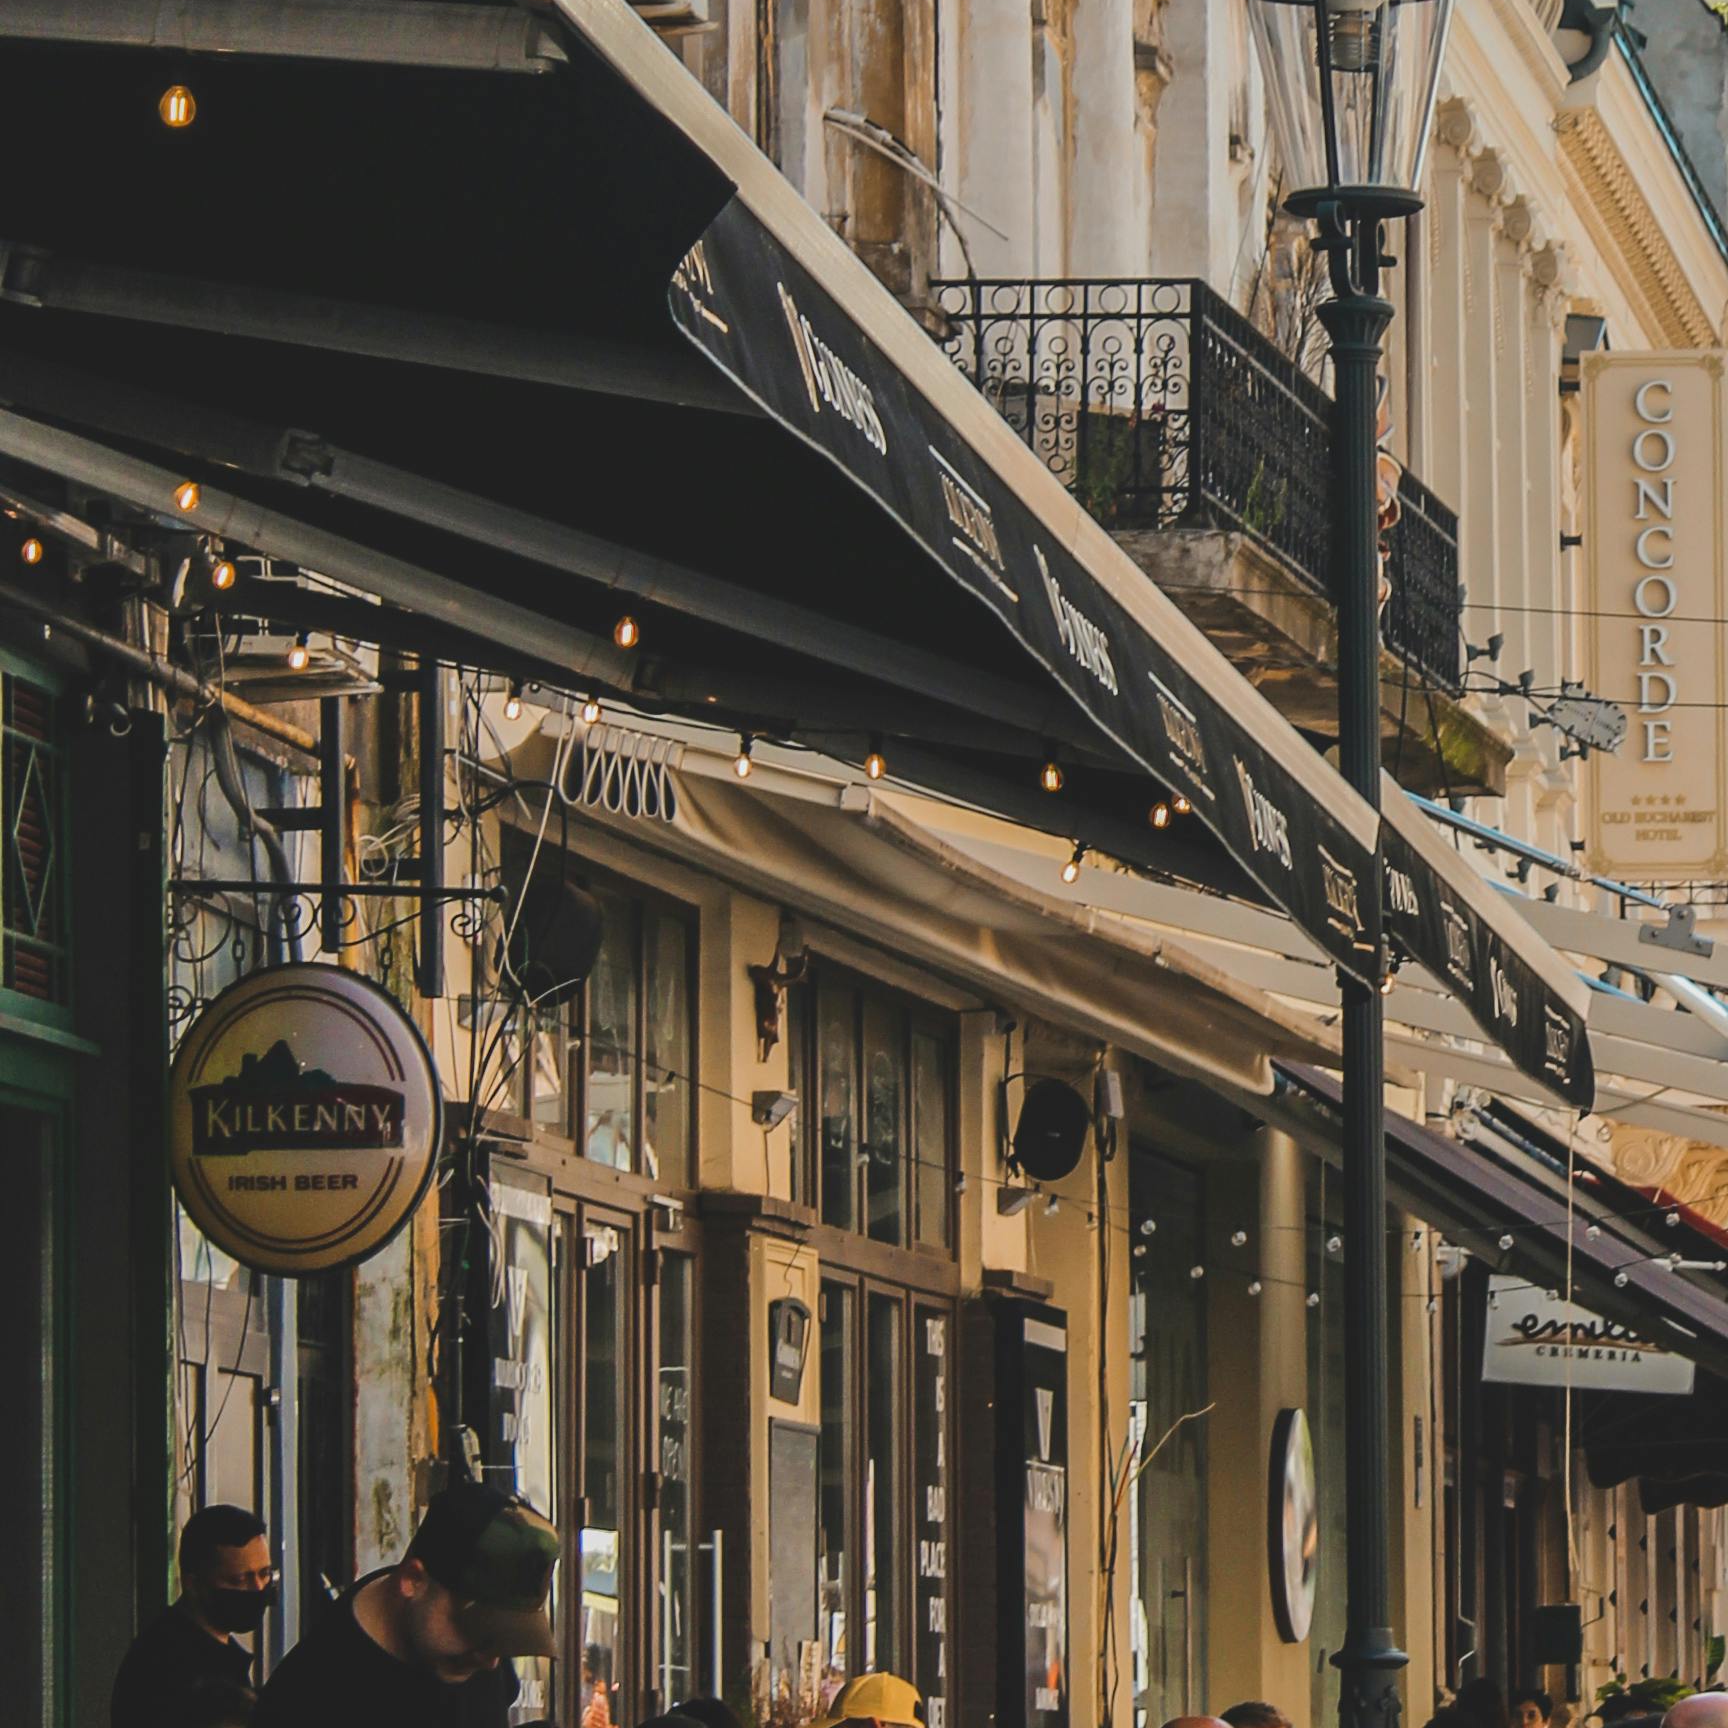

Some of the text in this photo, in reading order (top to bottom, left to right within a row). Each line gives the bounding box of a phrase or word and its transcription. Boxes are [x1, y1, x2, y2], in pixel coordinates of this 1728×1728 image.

[1632, 380, 1678, 762] CONCORDE
[1601, 811, 1632, 824] OLD
[1634, 828, 1682, 842] HOTEL
[207, 1099, 391, 1138] KILKENNY
[228, 1174, 358, 1191] IRISH BEER
[1535, 1344, 1642, 1363] CREMERIA
[920, 1540, 946, 1578] PLACE
[928, 1596, 946, 1633] FOR
